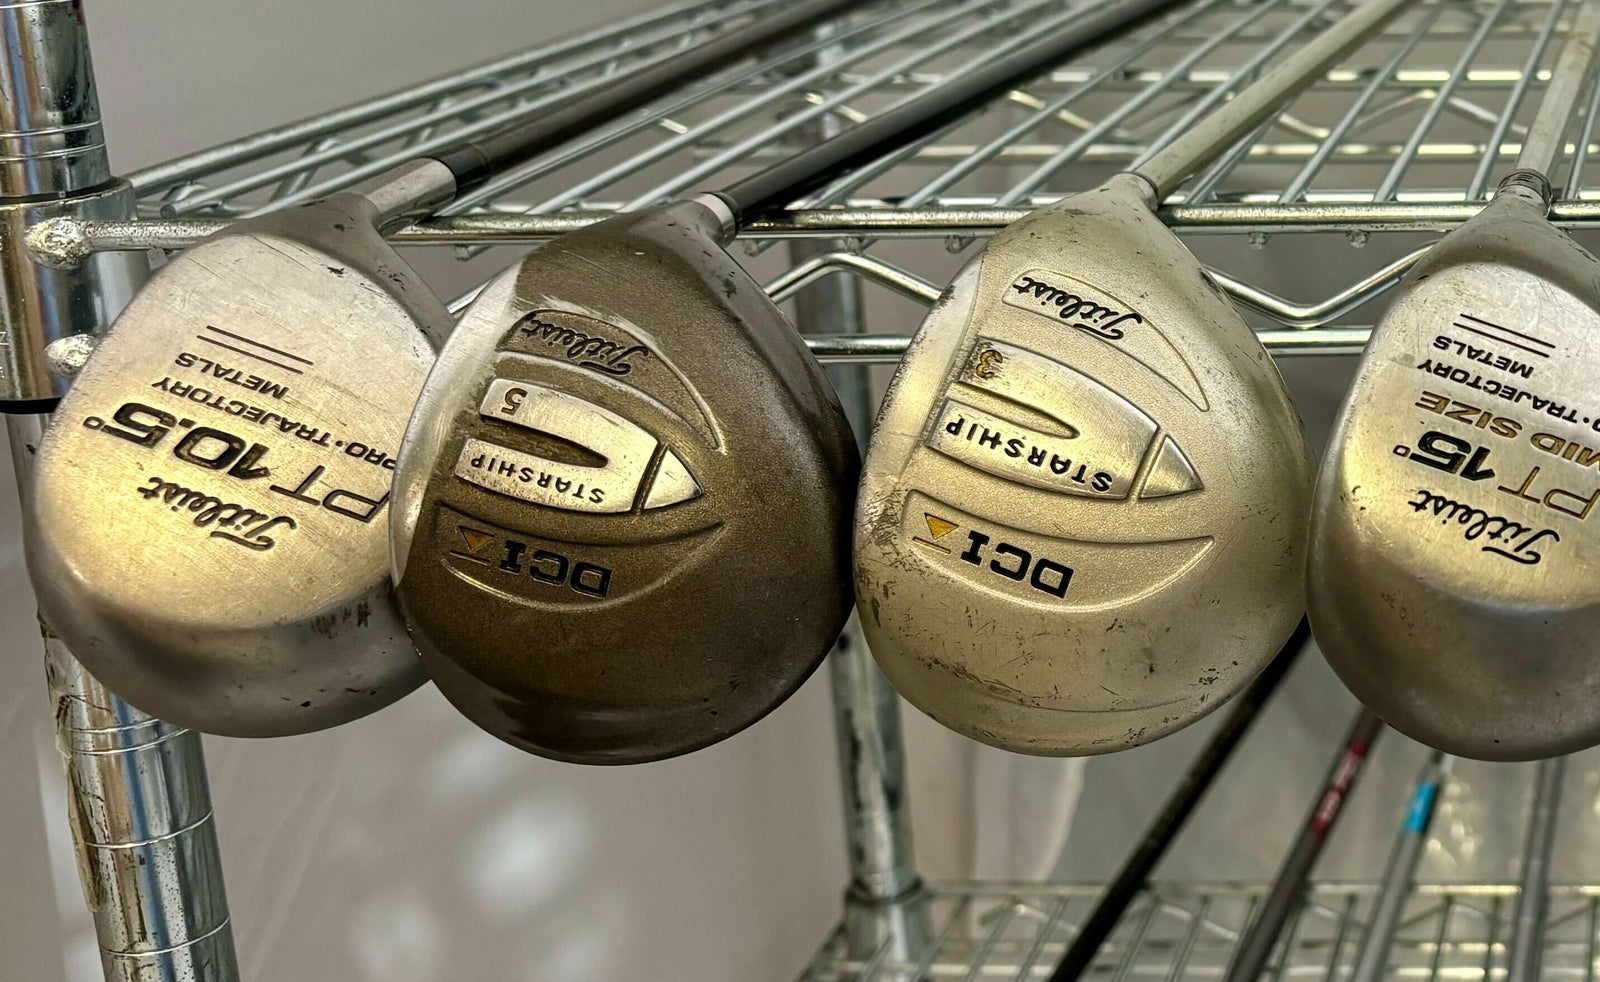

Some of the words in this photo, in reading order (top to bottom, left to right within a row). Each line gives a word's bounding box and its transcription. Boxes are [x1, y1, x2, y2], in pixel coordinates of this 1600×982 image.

[1013, 276, 1142, 340] Titleist
[521, 319, 648, 375] Titleist
[976, 349, 1003, 379] 3
[1433, 335, 1535, 379] METALS
[175, 352, 290, 399] METALS
[501, 387, 528, 415] 5
[83, 401, 271, 480] 10.5°
[1415, 391, 1523, 439] SIZE
[470, 453, 606, 503] STARSHIP
[946, 414, 1112, 492] STARSHIP
[1392, 431, 1496, 481] 15°
[137, 476, 298, 551] Titleist
[270, 465, 391, 523] PT
[1408, 490, 1560, 565] Titleist
[499, 540, 613, 597] DCI
[960, 530, 1074, 599] DCI
